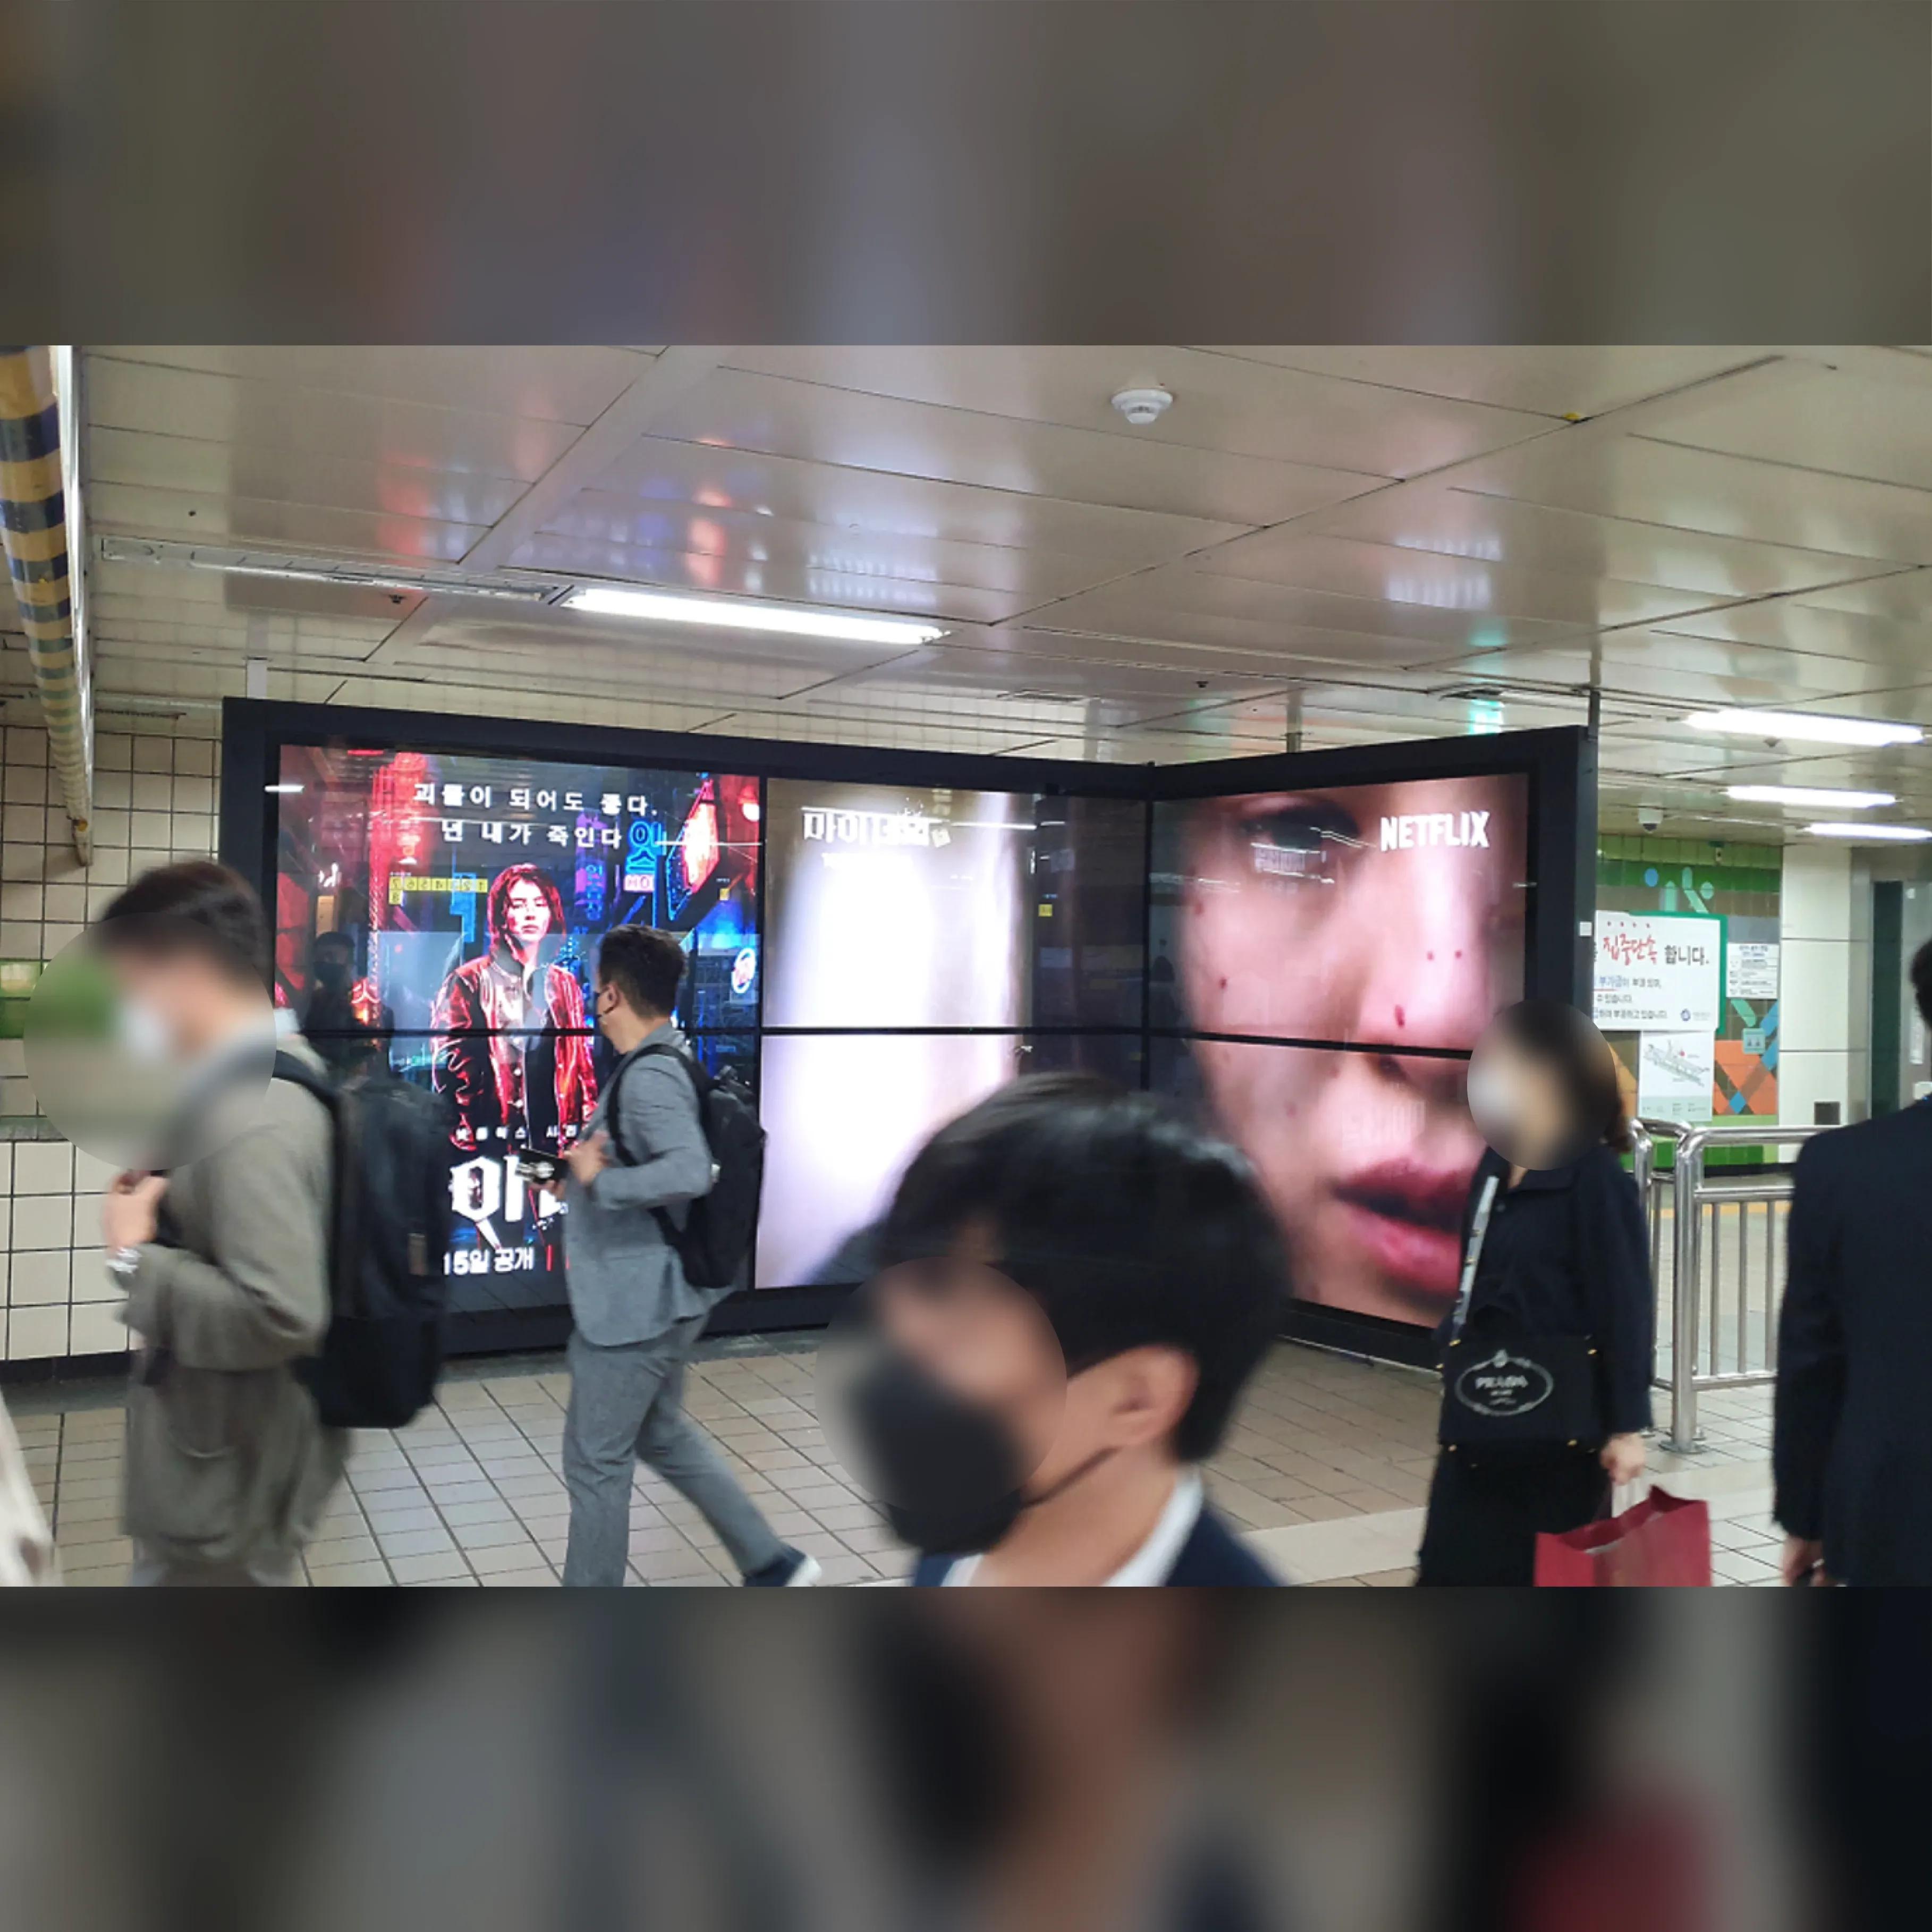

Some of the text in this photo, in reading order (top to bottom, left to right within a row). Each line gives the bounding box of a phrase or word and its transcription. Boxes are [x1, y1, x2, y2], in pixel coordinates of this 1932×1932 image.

[509, 787, 583, 811] 되어도
[599, 793, 658, 817] 좋다.
[481, 822, 531, 844] 내가
[547, 824, 622, 849] 죽인다
[1380, 810, 1490, 852] NETFLIX
[1664, 945, 1710, 966] 합니다.
[444, 1247, 534, 1275] 15일 공개
